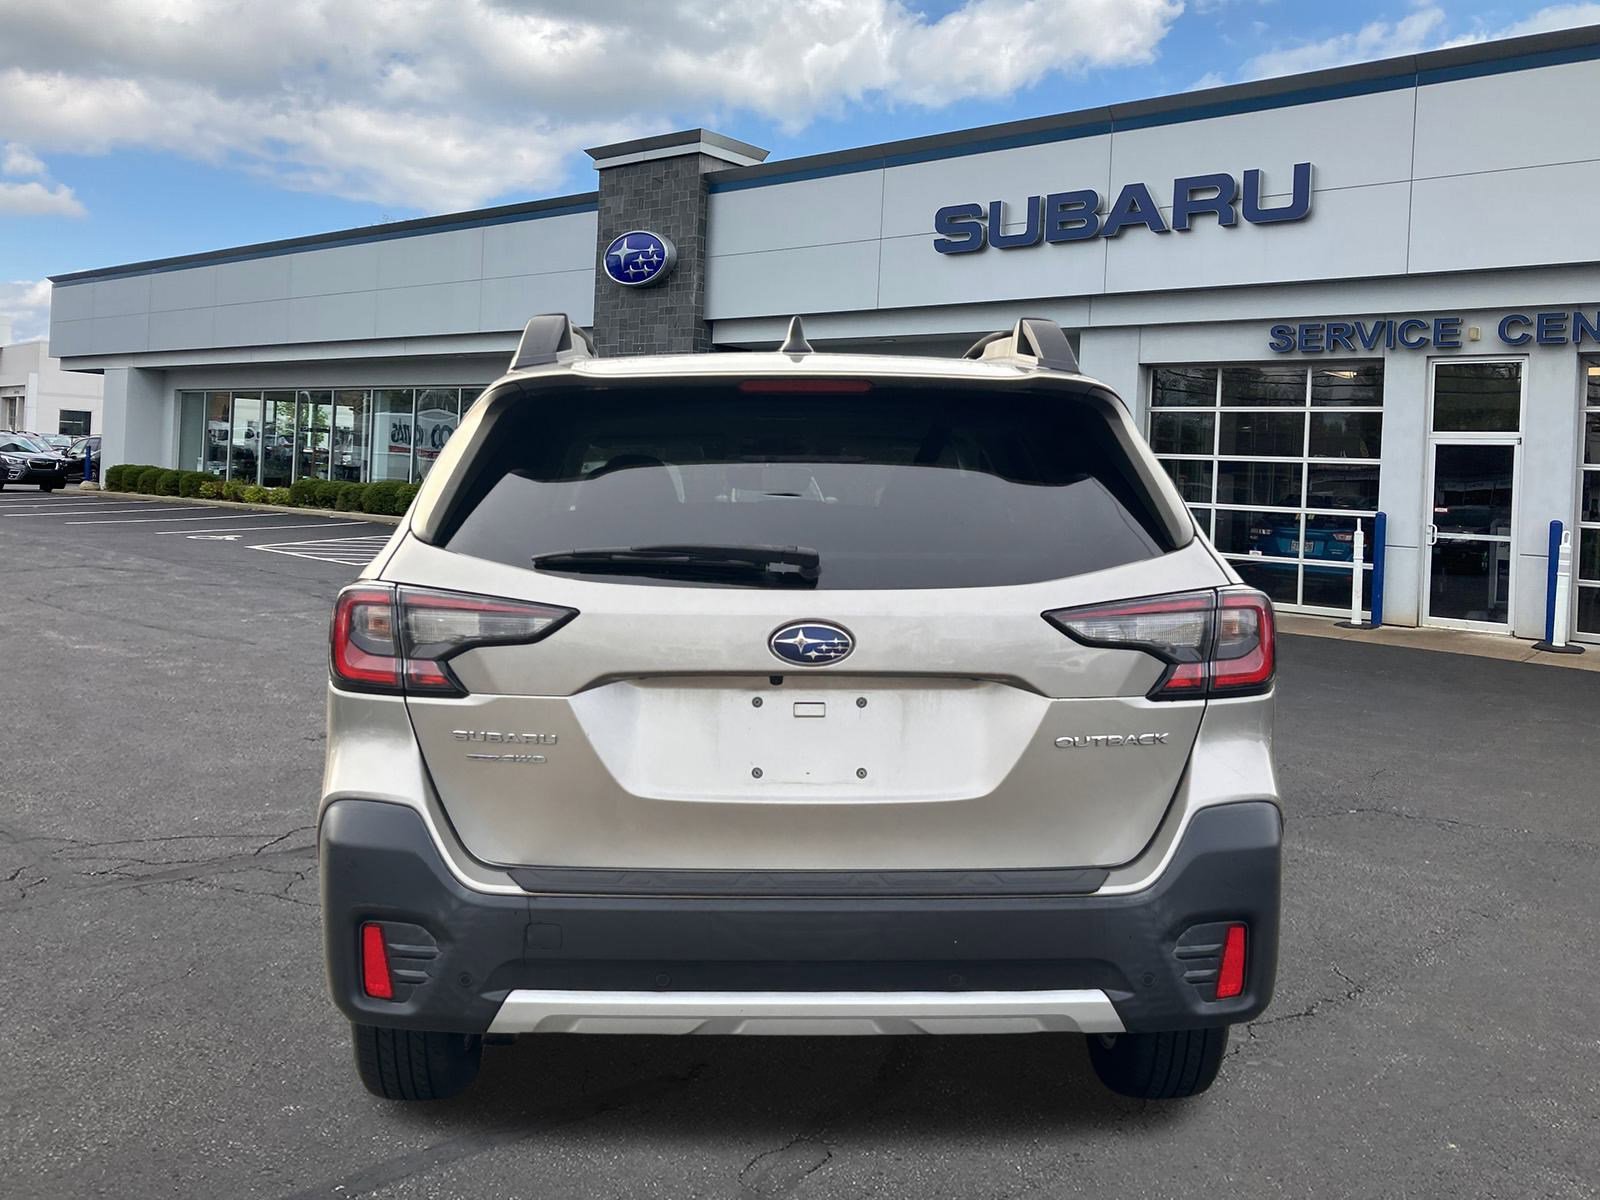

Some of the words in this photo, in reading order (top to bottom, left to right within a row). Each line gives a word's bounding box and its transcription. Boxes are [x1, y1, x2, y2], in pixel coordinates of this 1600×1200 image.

[933, 161, 1313, 255] SUBARU
[1269, 316, 1463, 353] SERVICE
[451, 729, 558, 745] SUBARU
[1054, 731, 1169, 748] OUTBACK
